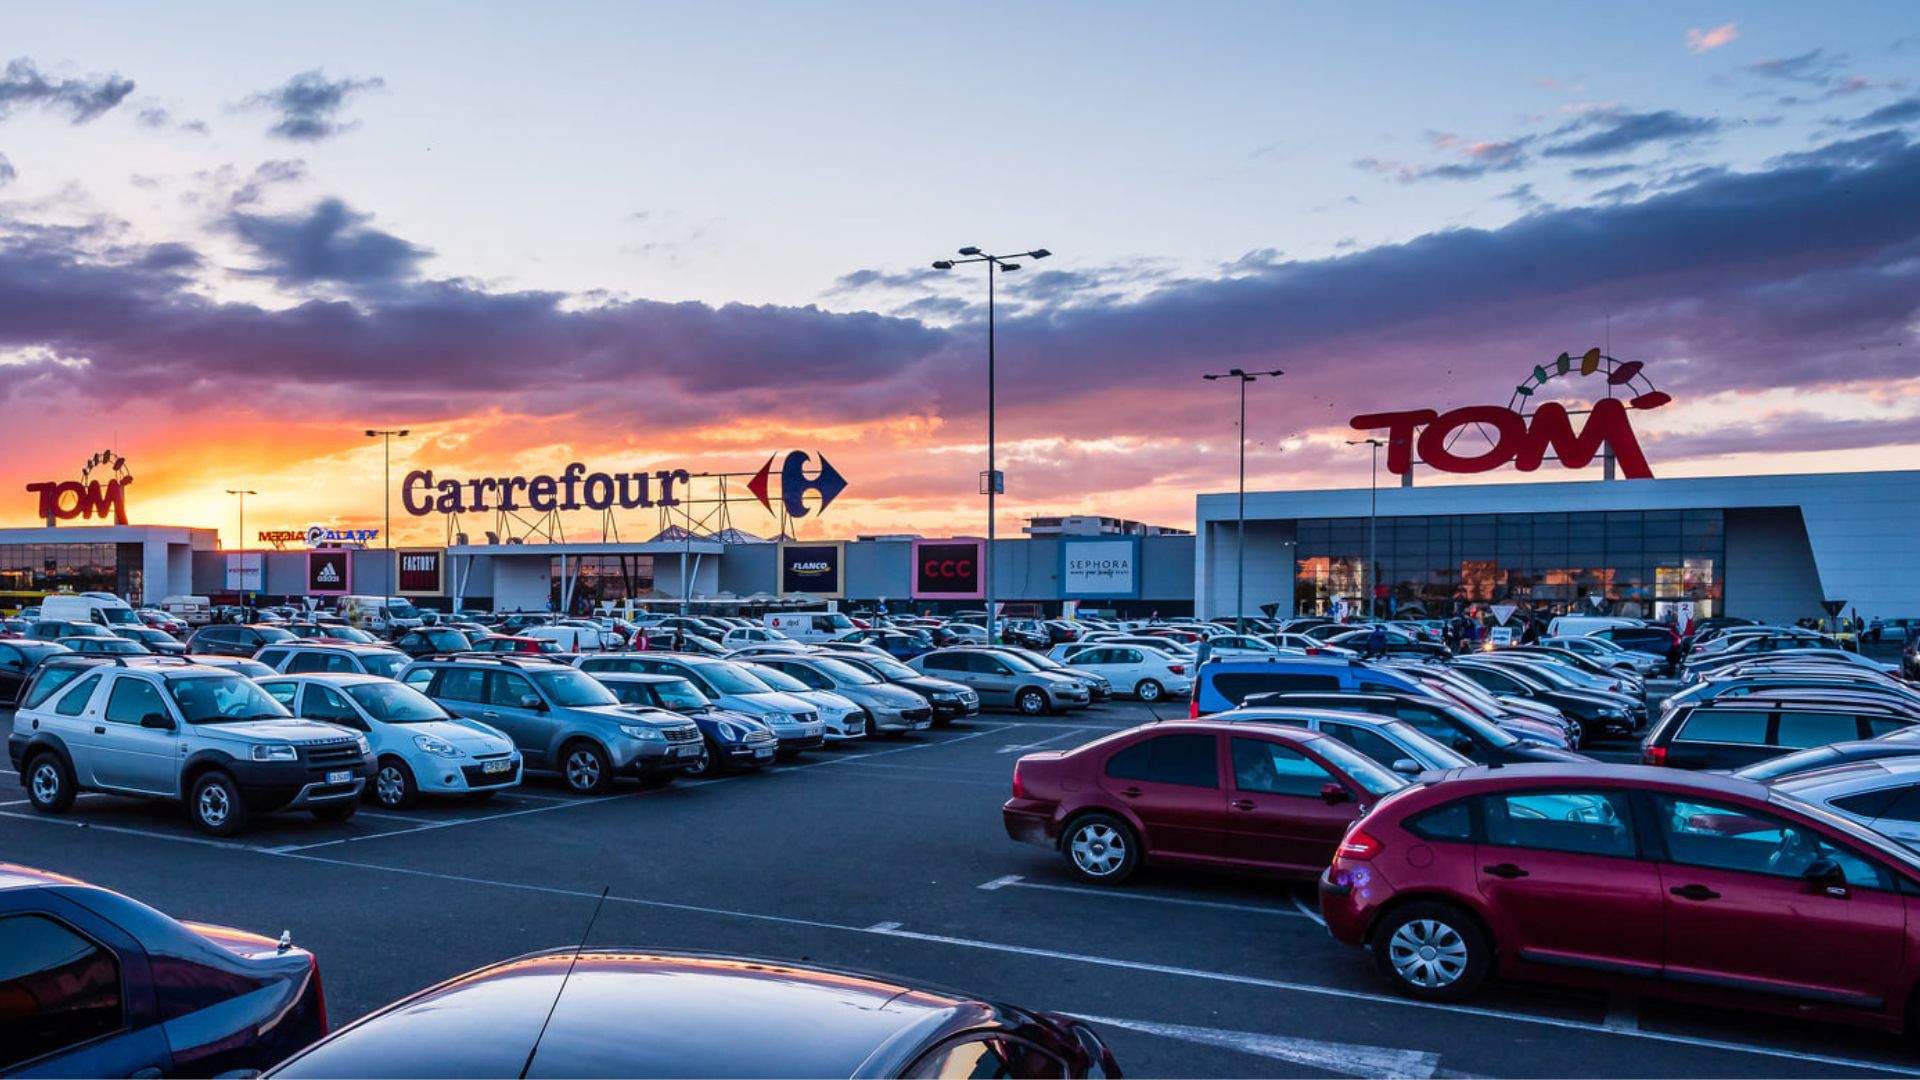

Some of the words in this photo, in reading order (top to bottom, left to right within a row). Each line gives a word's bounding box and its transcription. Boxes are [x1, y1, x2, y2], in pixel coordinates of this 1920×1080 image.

[1350, 398, 1655, 479] TOM
[402, 462, 689, 516] Carrefour
[26, 479, 128, 525] TOM
[258, 531, 306, 541] MEDIA
[307, 526, 379, 549] GALAXY
[403, 556, 435, 571] FACTORY
[793, 562, 828, 570] FLANCO
[925, 560, 971, 577] CCC
[1070, 560, 1128, 569] SEPHORA
[1681, 603, 1689, 611] 2
